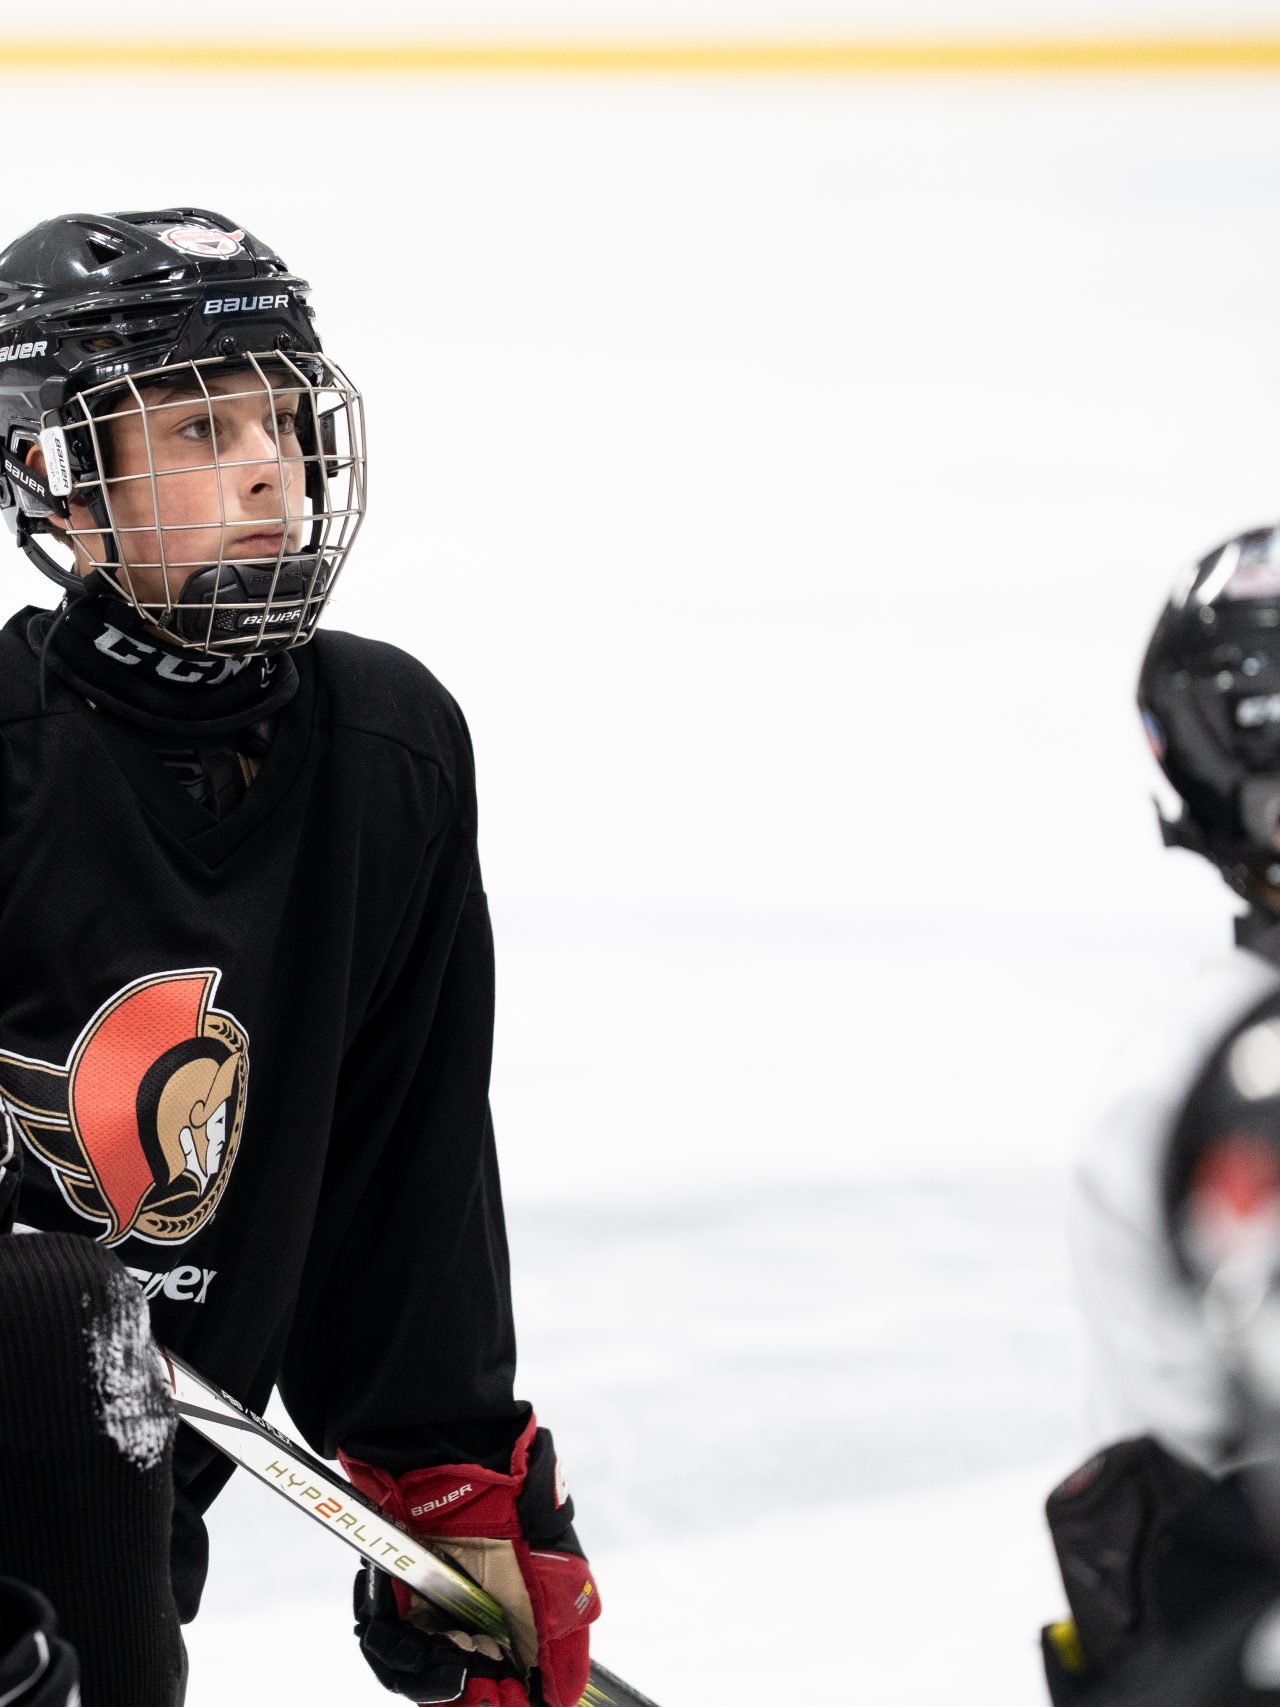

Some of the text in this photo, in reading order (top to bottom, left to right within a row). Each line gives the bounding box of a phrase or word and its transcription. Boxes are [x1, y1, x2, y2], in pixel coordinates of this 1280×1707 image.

[204, 295, 289, 314] BAUER
[5, 459, 45, 496] BAUER
[55, 438, 69, 488] BAUER
[243, 610, 301, 624] BAUER
[265, 1422, 293, 1448] FLEX
[265, 1460, 417, 1571] HYP2RLITE
[411, 1484, 472, 1517] BAUER
